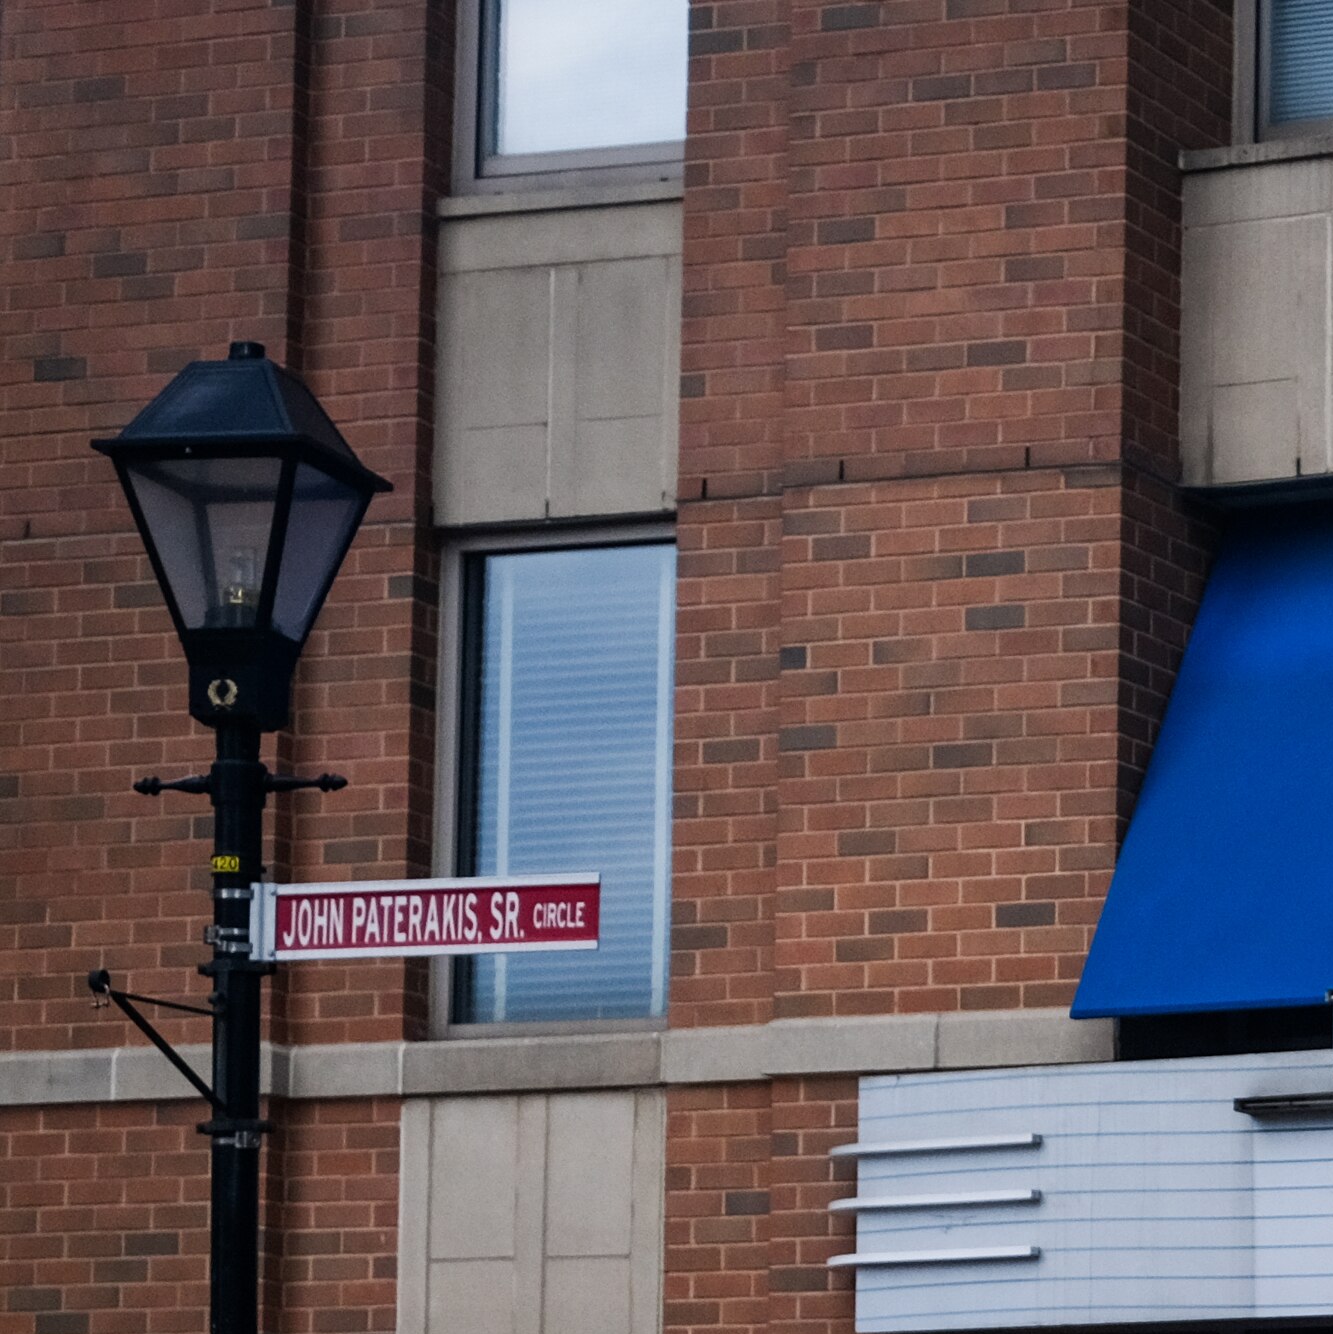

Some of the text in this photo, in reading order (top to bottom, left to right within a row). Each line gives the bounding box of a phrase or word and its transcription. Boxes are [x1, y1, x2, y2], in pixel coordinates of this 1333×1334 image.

[282, 891, 586, 947] JOHN PATERAKIS, SR. CIRCLE
